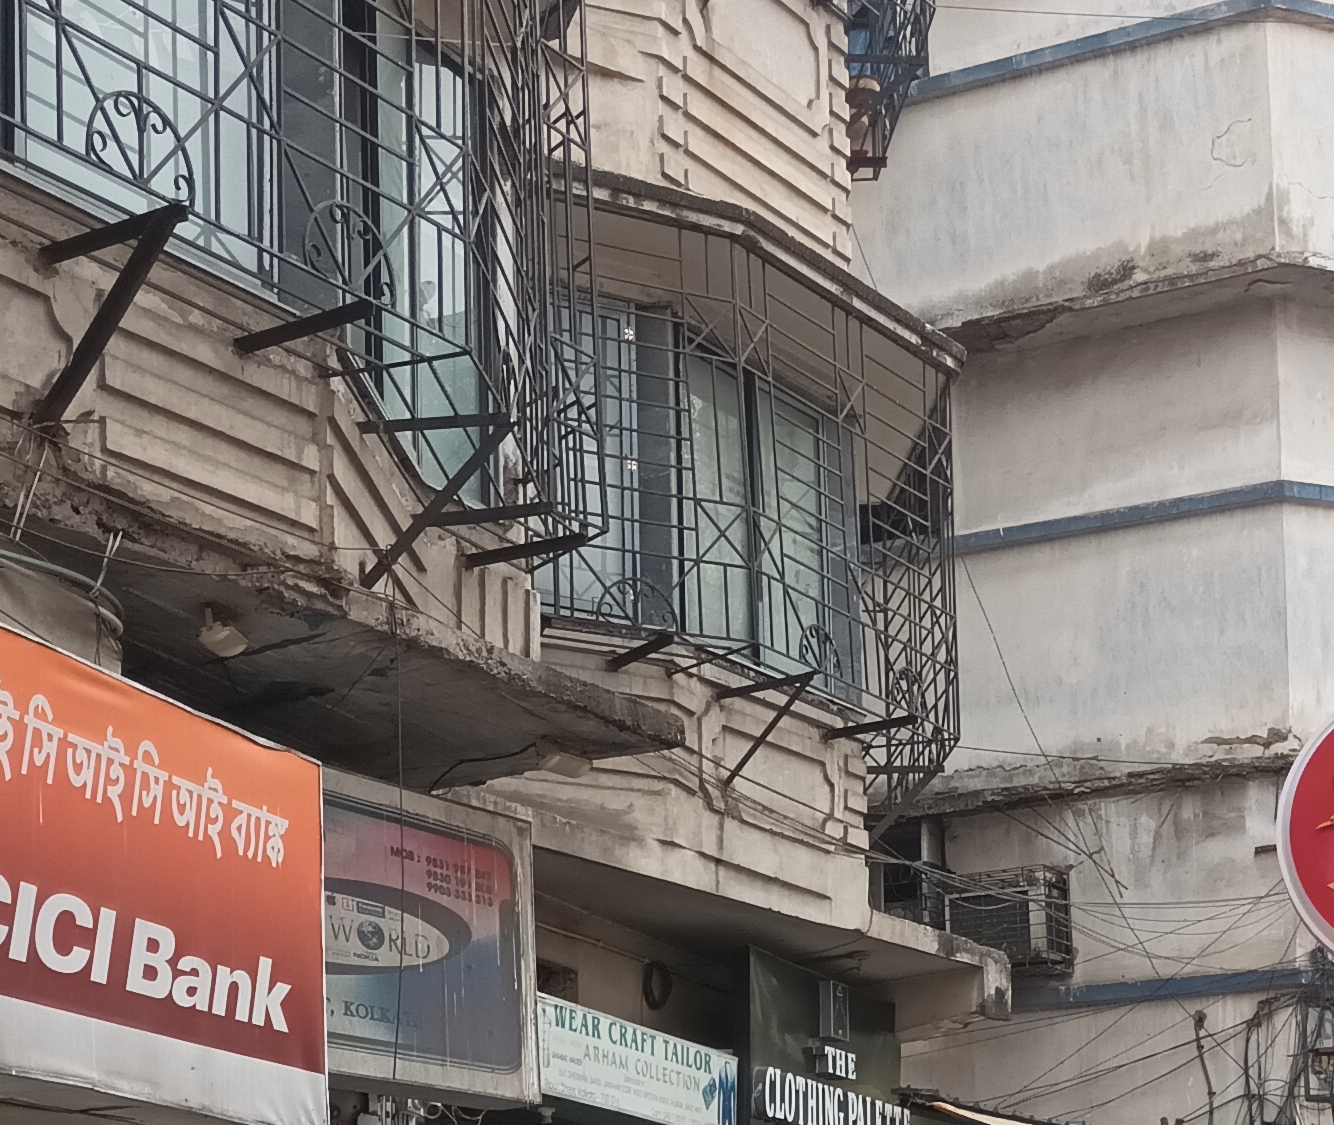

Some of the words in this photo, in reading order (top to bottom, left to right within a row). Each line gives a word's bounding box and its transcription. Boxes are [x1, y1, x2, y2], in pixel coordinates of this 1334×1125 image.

[21, 694, 64, 785] সি
[66, 727, 130, 822] আই
[132, 740, 167, 826] সি
[170, 767, 228, 859] আই
[125, 918, 292, 1033] Bank
[353, 952, 380, 962] NOKIA
[554, 1004, 601, 1040] WEAR
[608, 1022, 656, 1058] CRAFT
[663, 1039, 713, 1075] TAILOR
[583, 1044, 629, 1072] ARHAM
[635, 1058, 700, 1093] COLLECTION
[824, 1046, 857, 1081] THE
